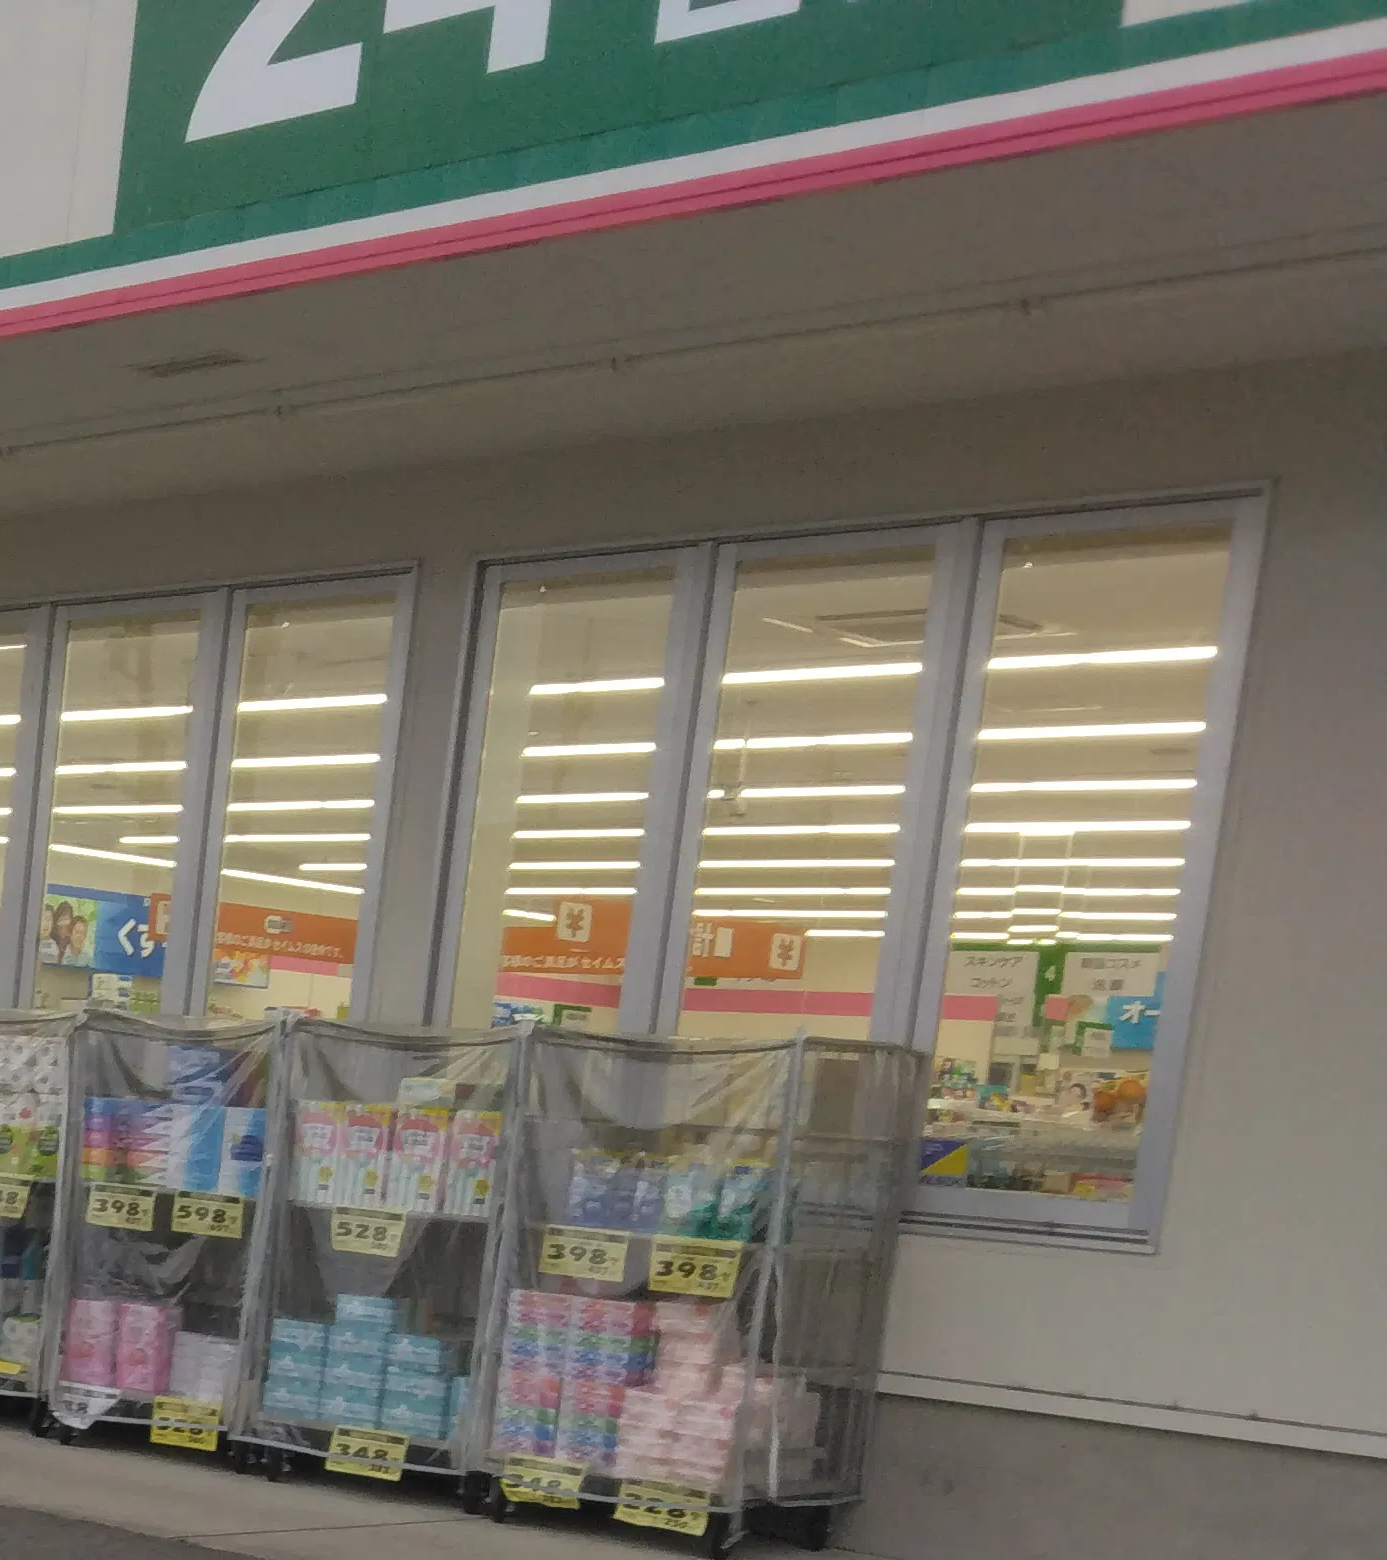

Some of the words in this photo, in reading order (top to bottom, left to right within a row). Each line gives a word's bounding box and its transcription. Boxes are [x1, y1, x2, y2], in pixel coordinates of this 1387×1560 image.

[91, 1198, 141, 1217] 398
[176, 1203, 228, 1224] 598
[334, 1221, 388, 1242] 528
[546, 1243, 608, 1265] 398
[654, 1259, 719, 1281] 398
